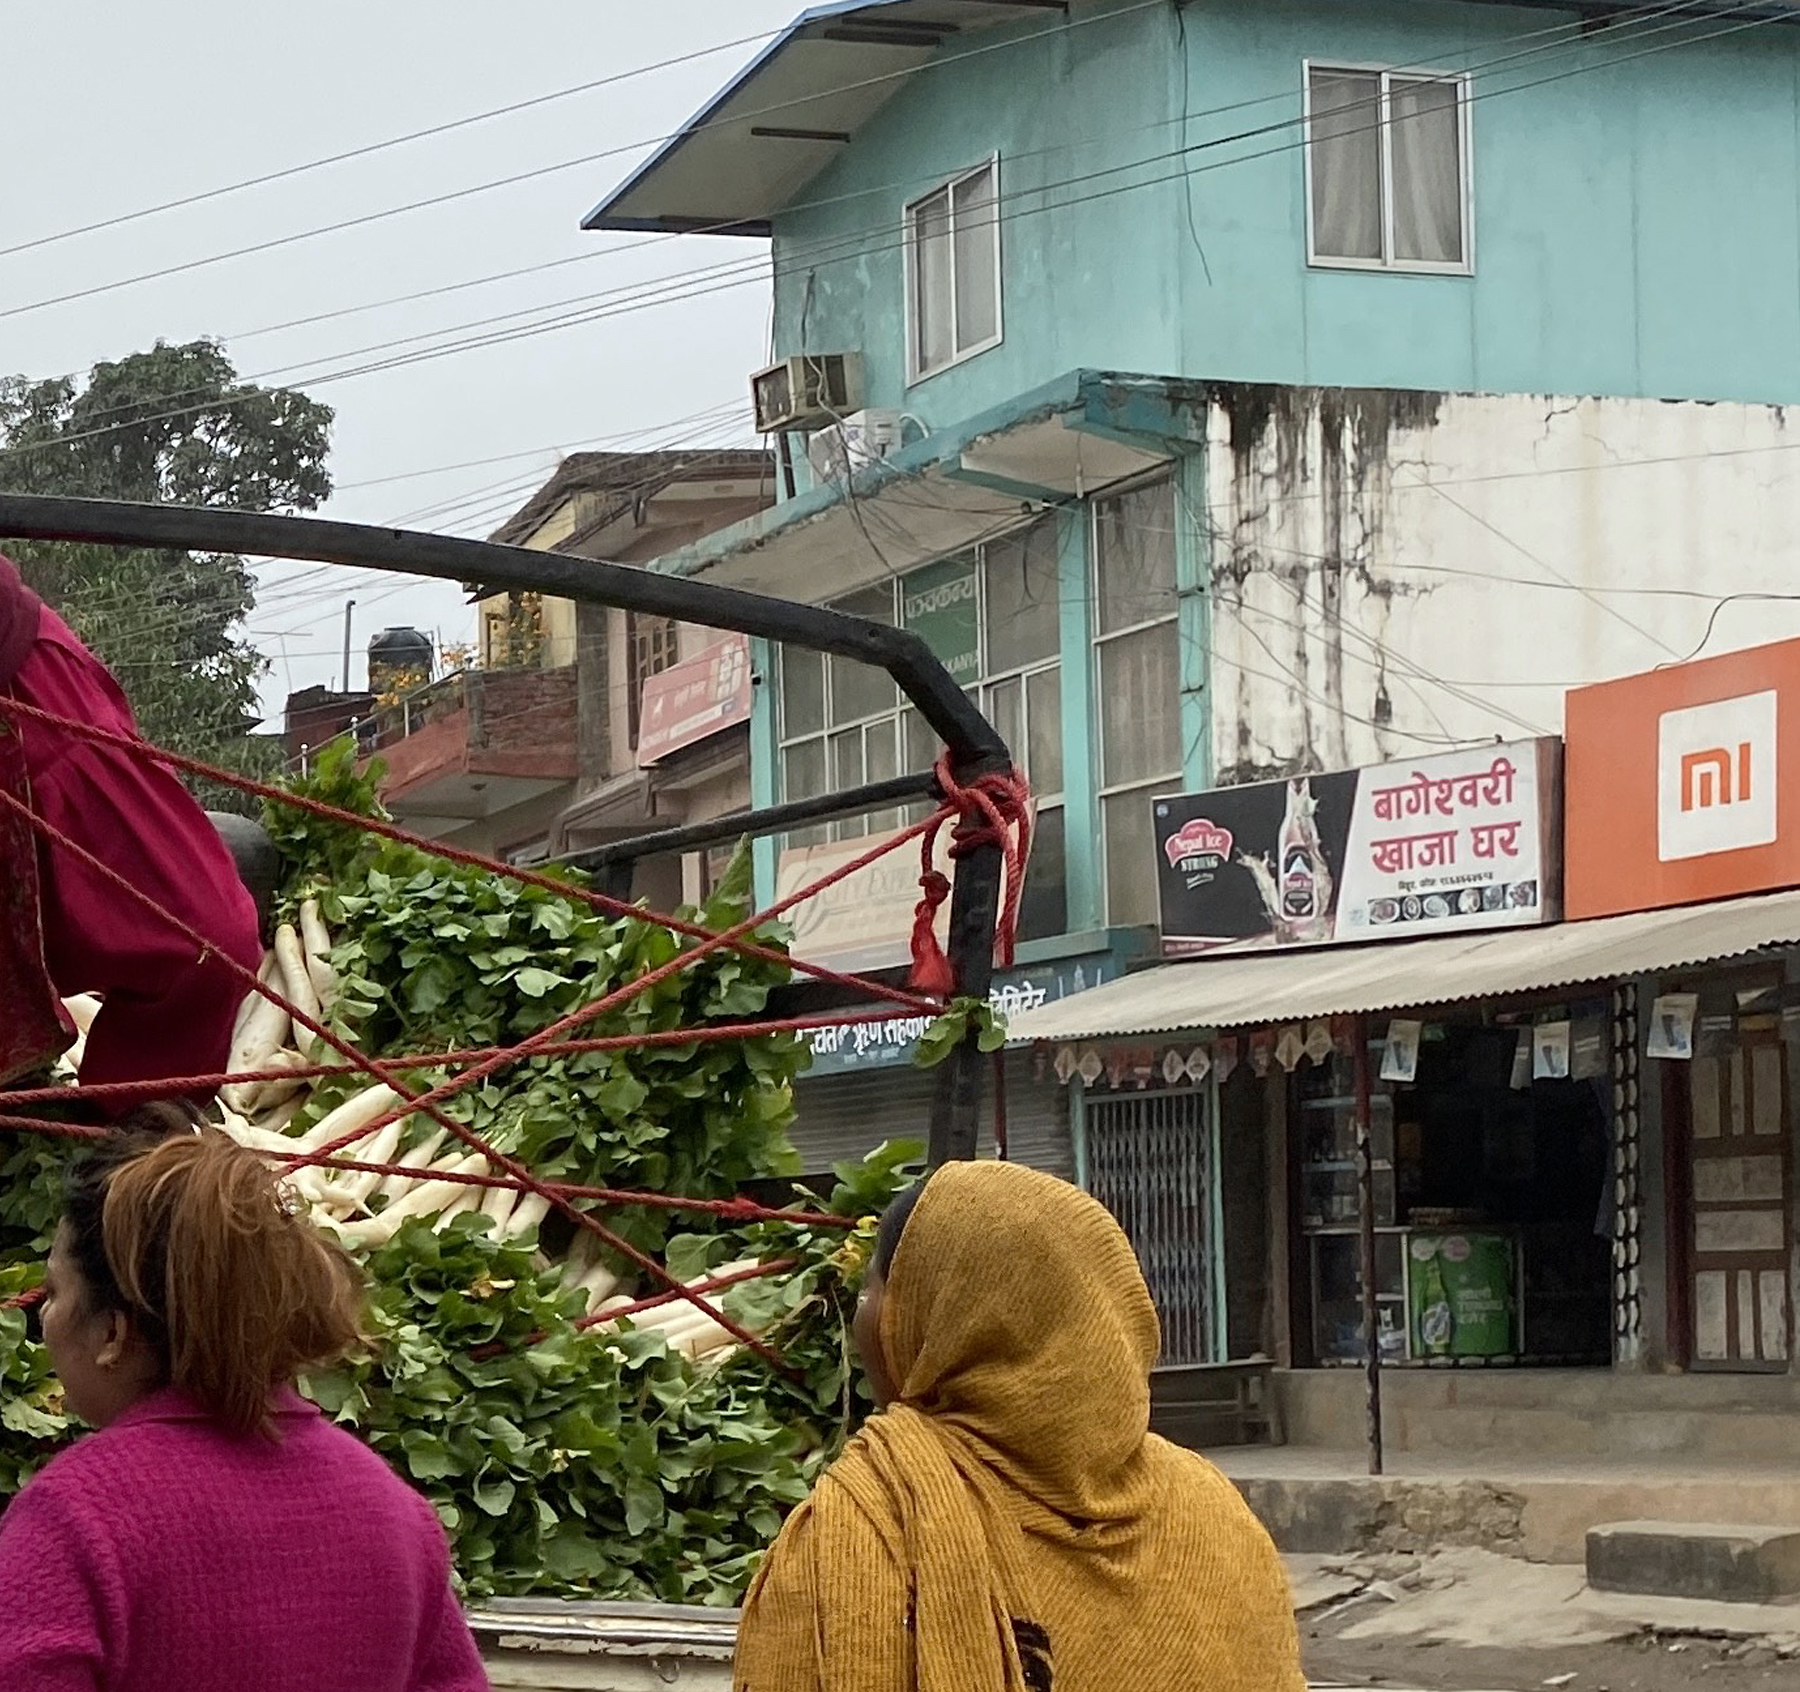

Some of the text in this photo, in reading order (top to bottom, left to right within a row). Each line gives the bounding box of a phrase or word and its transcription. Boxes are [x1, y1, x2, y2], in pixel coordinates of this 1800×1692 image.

[1371, 757, 1516, 820] बागेश्वरी
[1370, 821, 1522, 873] खाजा घर
